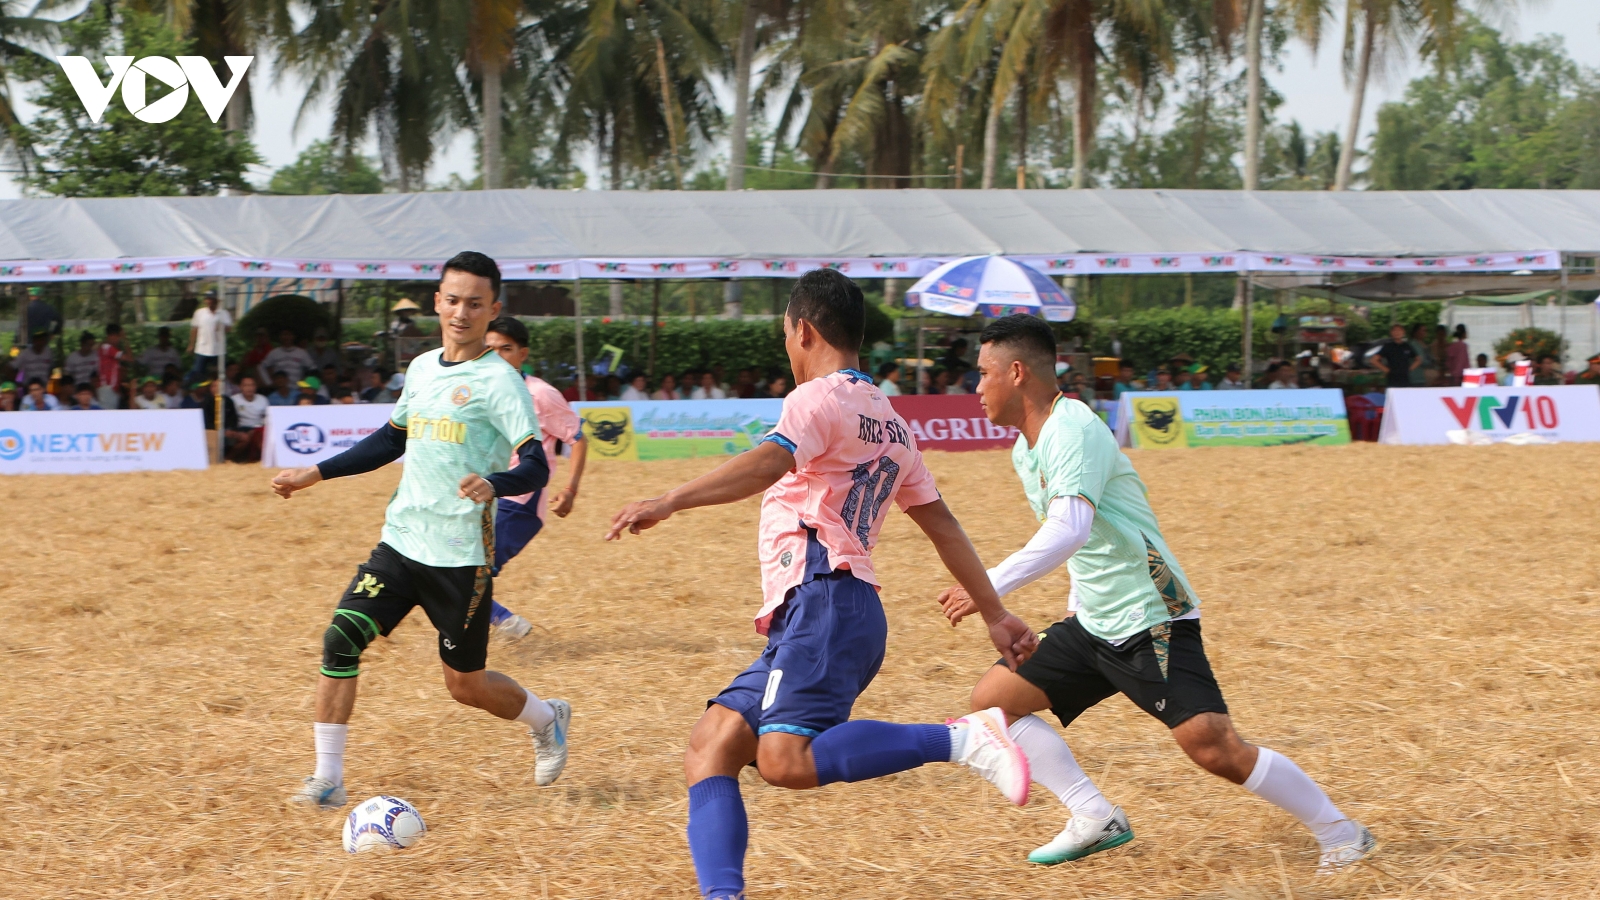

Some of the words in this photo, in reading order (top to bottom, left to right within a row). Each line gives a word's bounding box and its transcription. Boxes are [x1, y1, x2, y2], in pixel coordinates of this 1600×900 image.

[1441, 396, 1559, 429] VTV10
[30, 432, 166, 453] NEXTVIEW
[430, 415, 467, 444] TÔN
